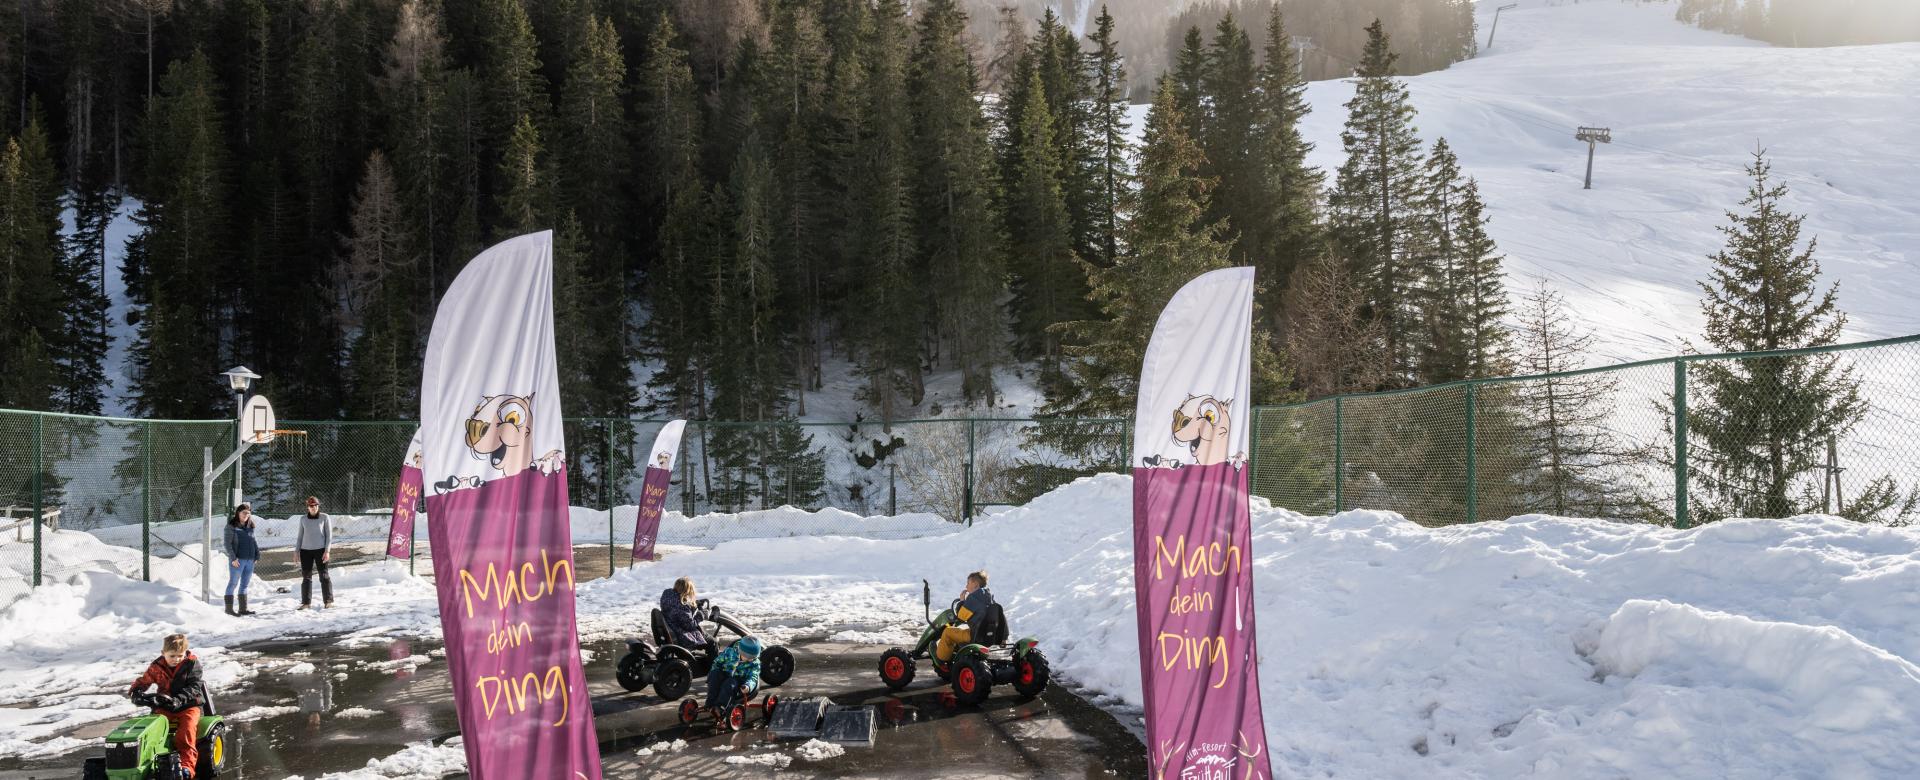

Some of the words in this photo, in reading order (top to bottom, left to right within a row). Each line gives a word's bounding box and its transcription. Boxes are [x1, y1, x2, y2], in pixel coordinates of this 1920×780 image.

[1155, 533, 1242, 580] Mach
[460, 548, 574, 619] Mach
[1170, 586, 1214, 617] dein
[487, 619, 533, 656] dein
[1158, 629, 1230, 690] Ding
